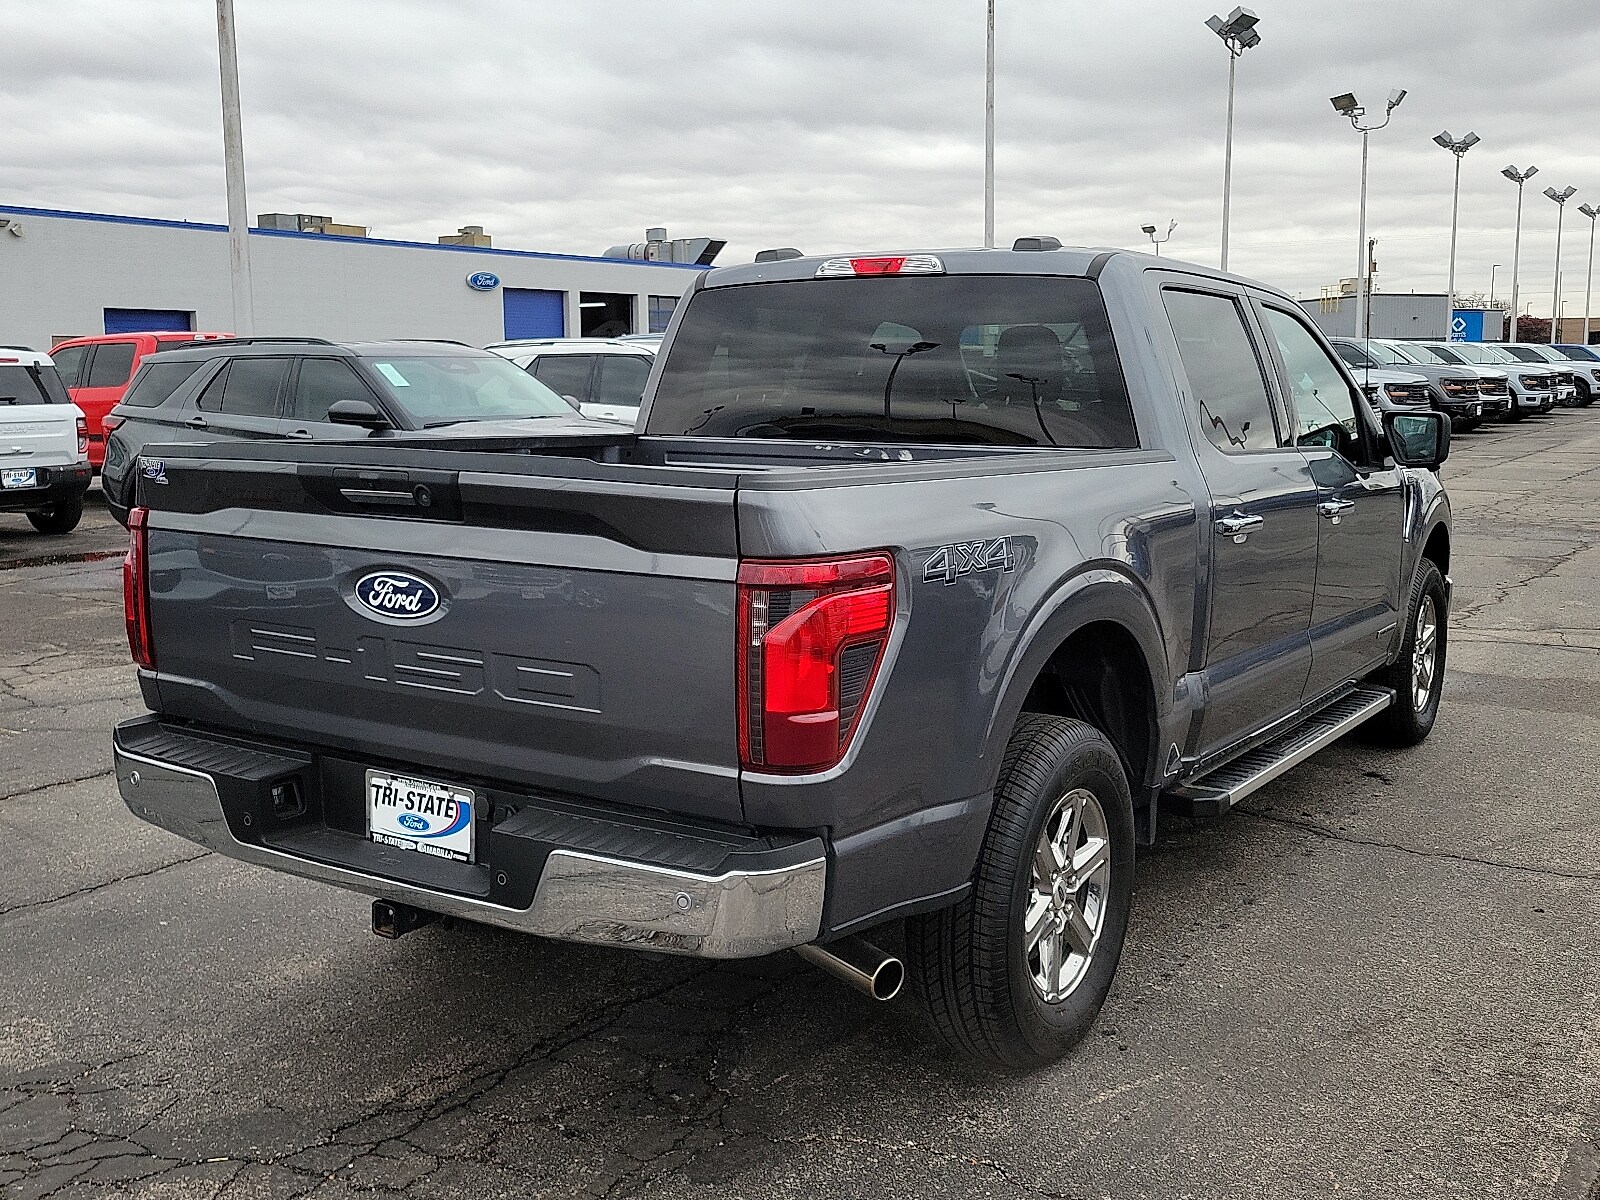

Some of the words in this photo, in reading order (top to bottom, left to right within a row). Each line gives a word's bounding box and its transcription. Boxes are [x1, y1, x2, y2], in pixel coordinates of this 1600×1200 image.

[476, 275, 495, 286] Ford
[368, 577, 423, 612] Ford
[231, 619, 602, 714] F-150
[370, 783, 457, 819] TRI-STATE
[403, 816, 424, 830] Ford
[372, 832, 401, 848] TRI-STATE
